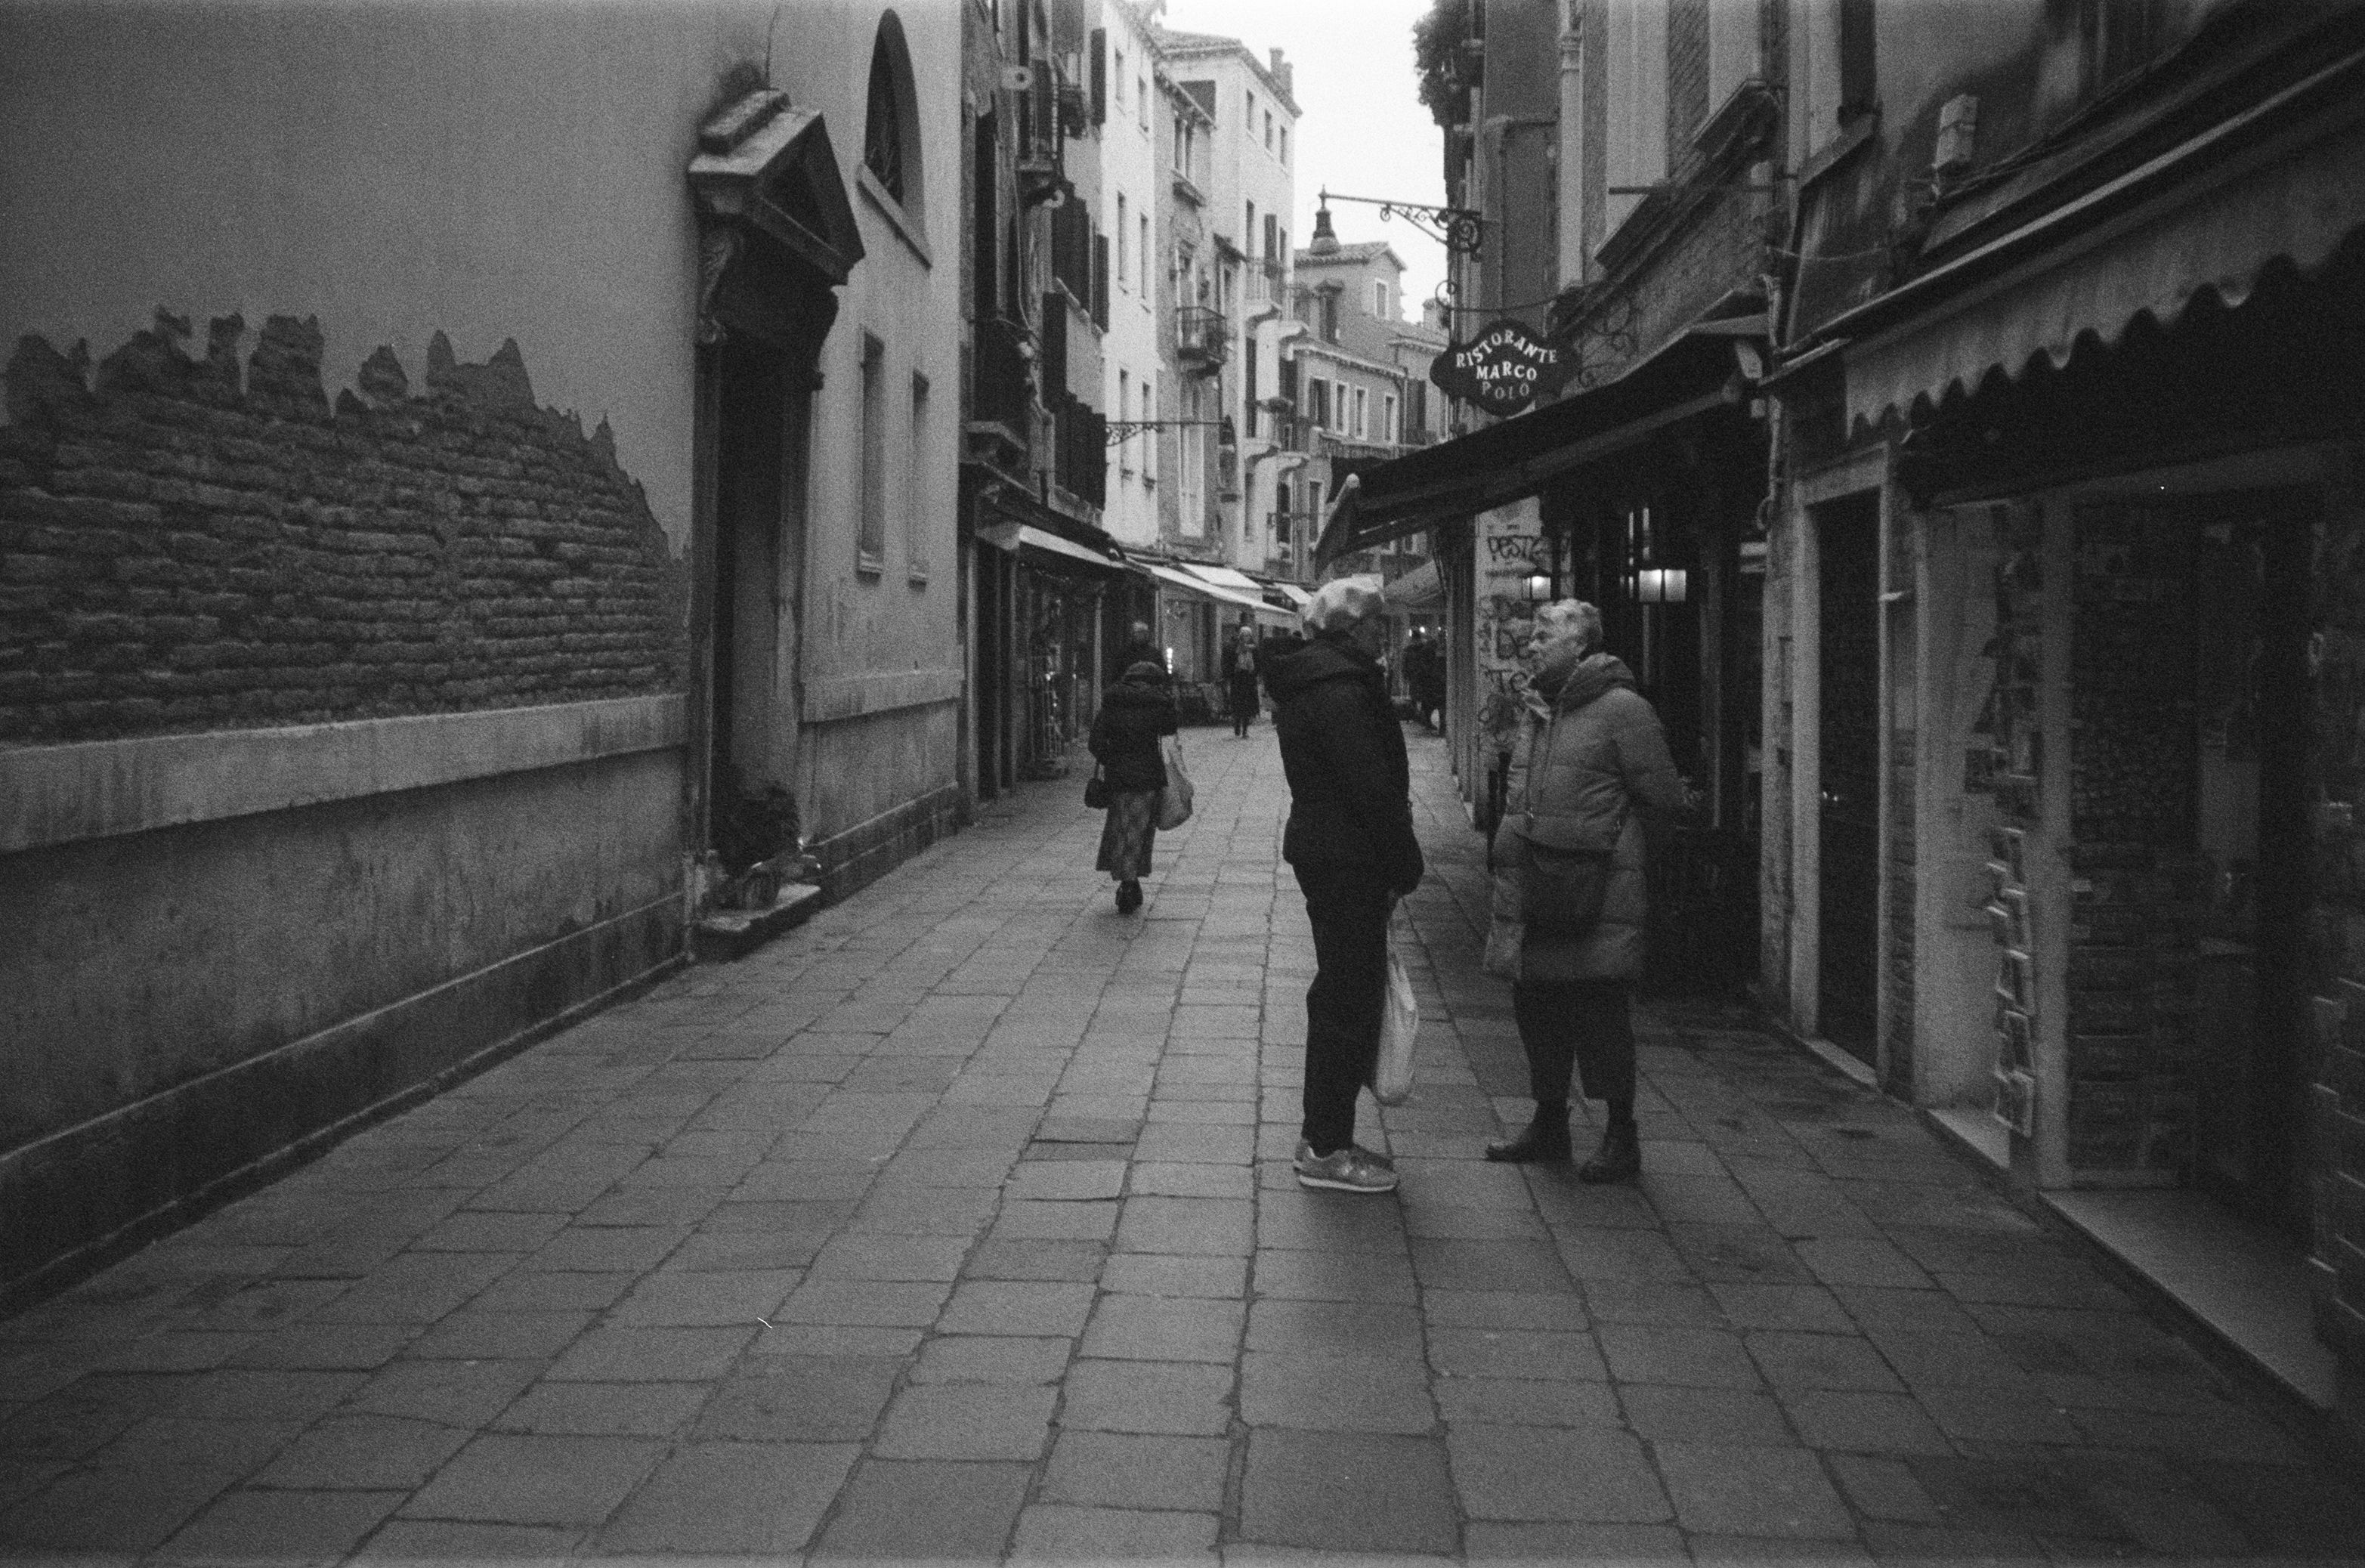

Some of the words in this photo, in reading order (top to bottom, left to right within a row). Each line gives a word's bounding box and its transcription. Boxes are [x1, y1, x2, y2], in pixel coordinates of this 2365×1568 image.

[1456, 329, 1558, 369] RISTORANTE
[1476, 360, 1538, 381] MARCO
[1482, 381, 1530, 400] POLO
